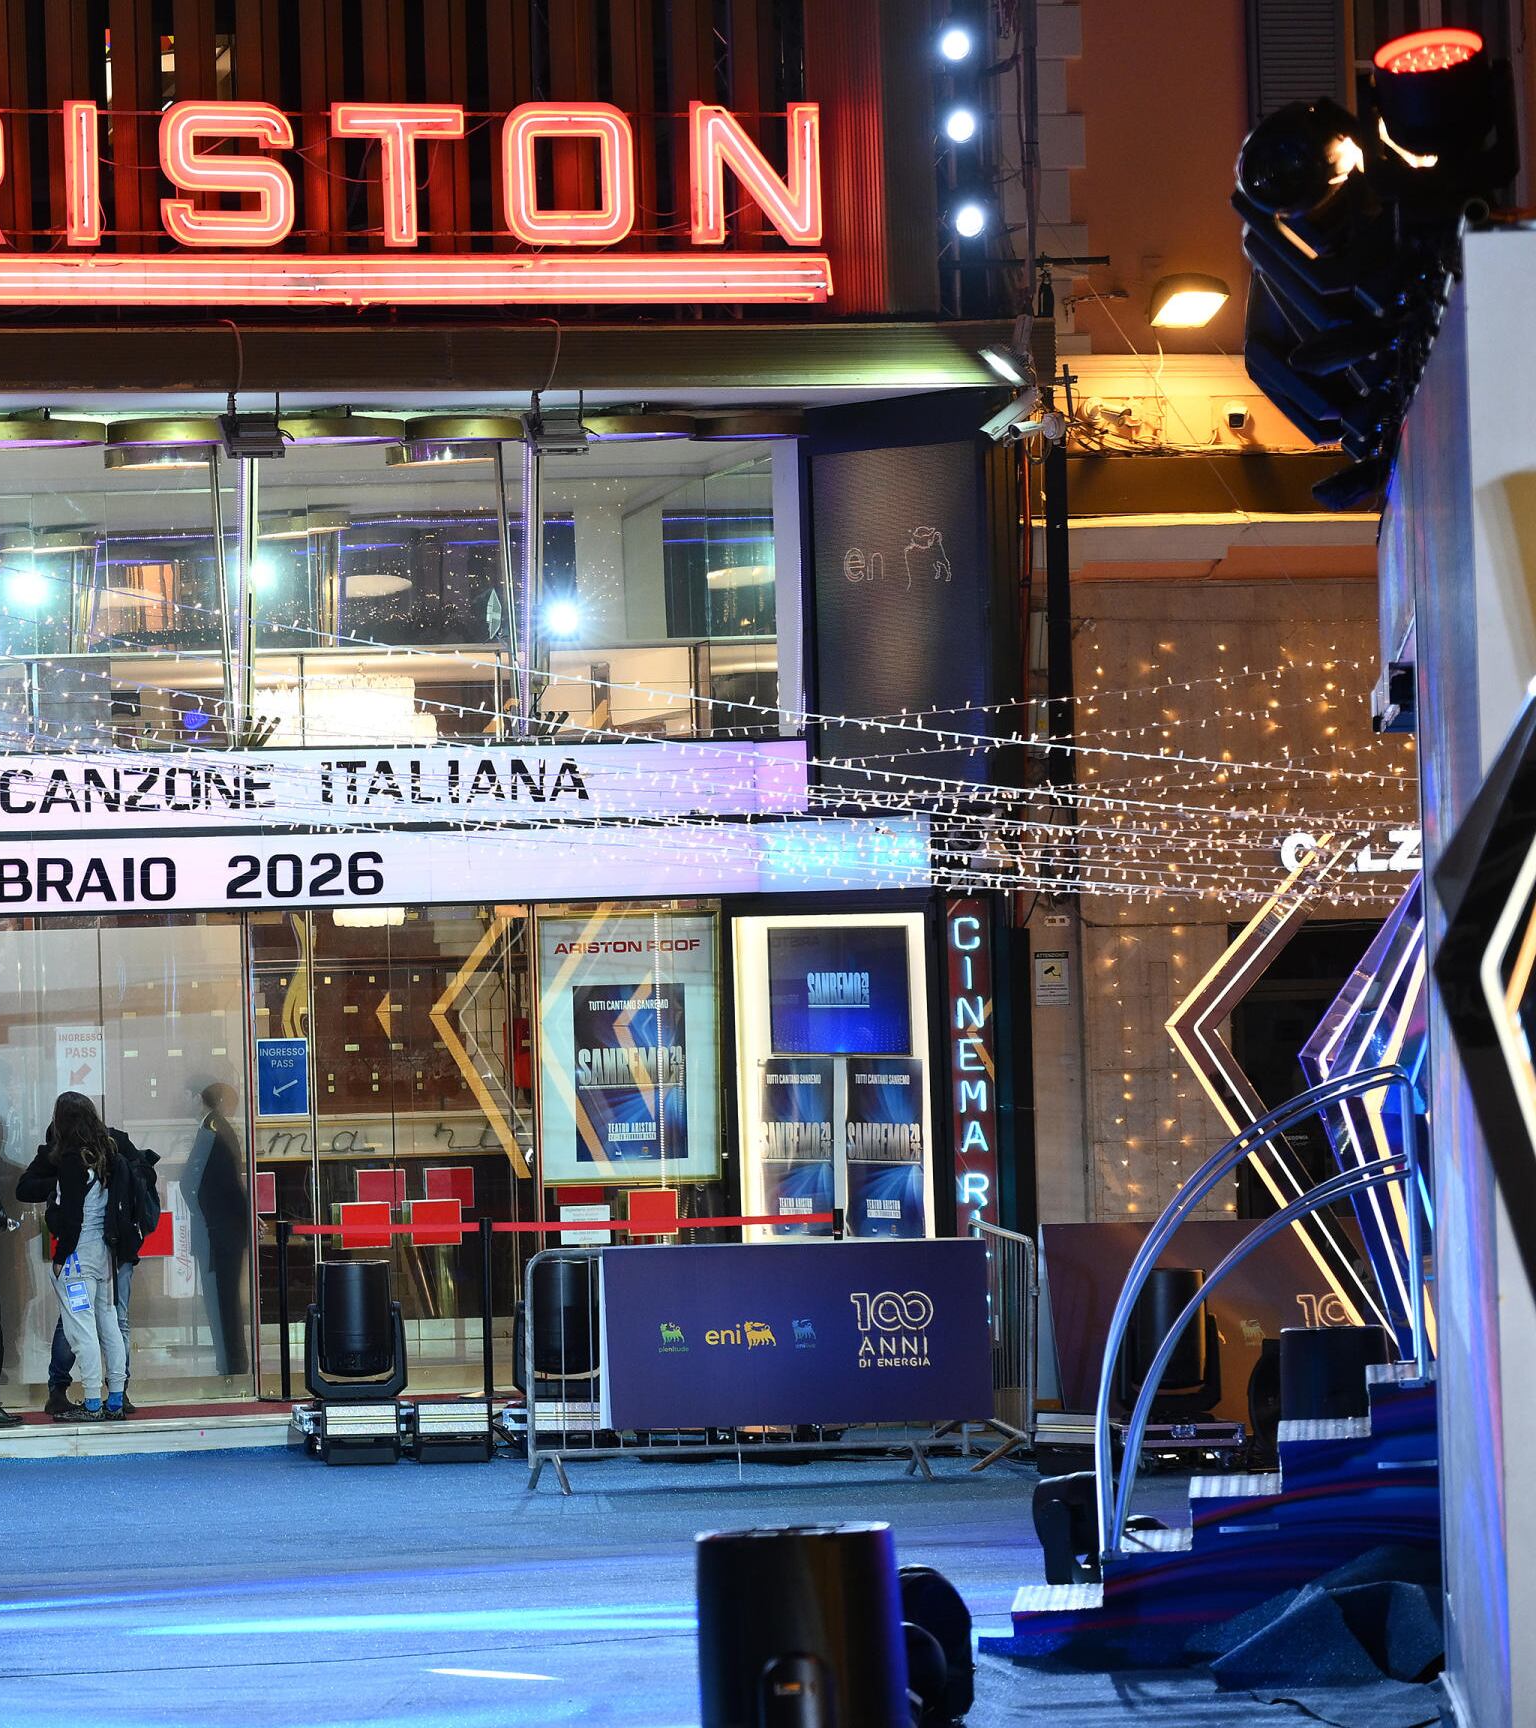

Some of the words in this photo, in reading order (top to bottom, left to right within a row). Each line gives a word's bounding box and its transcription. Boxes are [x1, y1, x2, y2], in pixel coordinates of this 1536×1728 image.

[0, 763, 276, 816] CANZONE
[321, 757, 590, 805] ITALIANA
[226, 850, 385, 899] 2026
[554, 941, 642, 955] ARISTON
[646, 939, 700, 951] ROOF
[807, 972, 861, 1005] SANREMO
[588, 1001, 606, 1011] TUTTI
[606, 999, 637, 1011] CANTANO
[637, 999, 669, 1010] SANREMO
[59, 1034, 103, 1042] INGRESSO
[952, 916, 991, 1153] CINEMA
[65, 1047, 97, 1058] PASS
[259, 1047, 305, 1057] INGRESSO
[271, 1060, 294, 1068] PASS
[578, 1046, 670, 1086] SANREMO
[761, 1122, 821, 1159] SANREMO
[848, 1123, 910, 1160] SANREMO
[850, 1290, 934, 1332] 100
[705, 1324, 742, 1345] eni
[859, 1336, 928, 1357] ANNI
[859, 1358, 872, 1368] DI
[876, 1356, 931, 1367] ENERGIA
